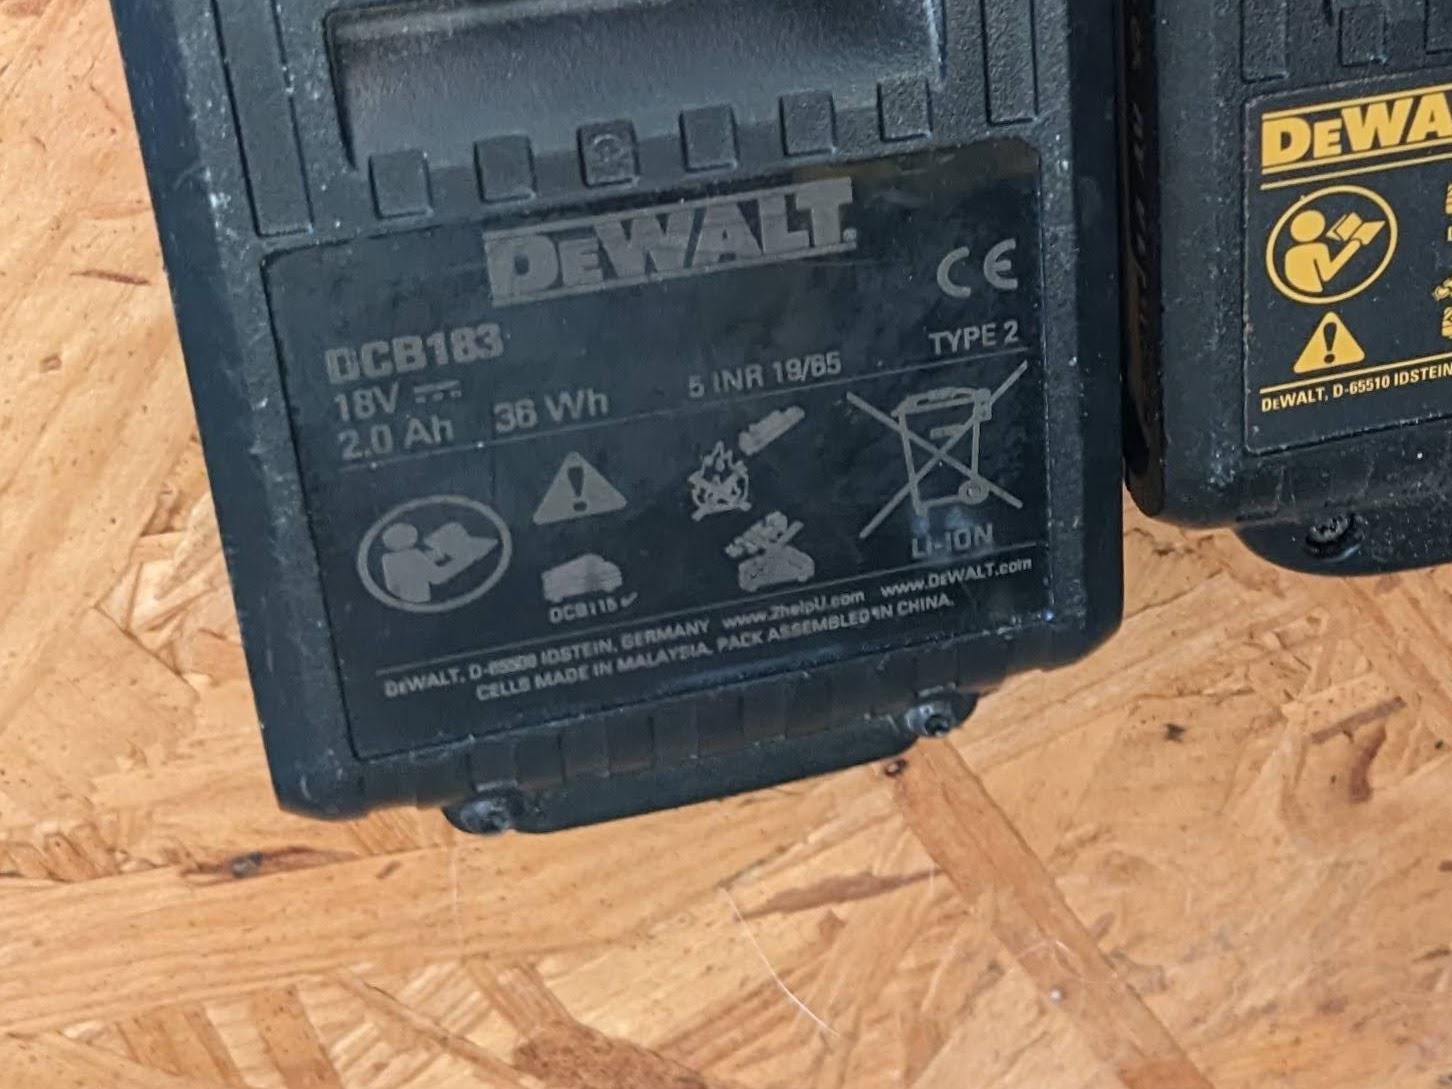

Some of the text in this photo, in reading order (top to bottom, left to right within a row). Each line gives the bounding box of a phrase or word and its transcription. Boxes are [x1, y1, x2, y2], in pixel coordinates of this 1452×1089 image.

[937, 238, 1018, 298] CE
[324, 322, 504, 384] DCB183
[929, 320, 1019, 355] TYPE 2
[712, 363, 764, 394] INR
[1332, 377, 1390, 398] D-65510
[334, 381, 399, 421] 18V
[338, 386, 609, 460] 2.0 Ah 36 Wh
[476, 677, 531, 701] CELLS
[535, 665, 589, 689] MADE
[593, 661, 614, 677] IN
[716, 630, 764, 653] PACK
[768, 607, 870, 642] ASSEMBLED
[621, 619, 710, 649] GERMANY
